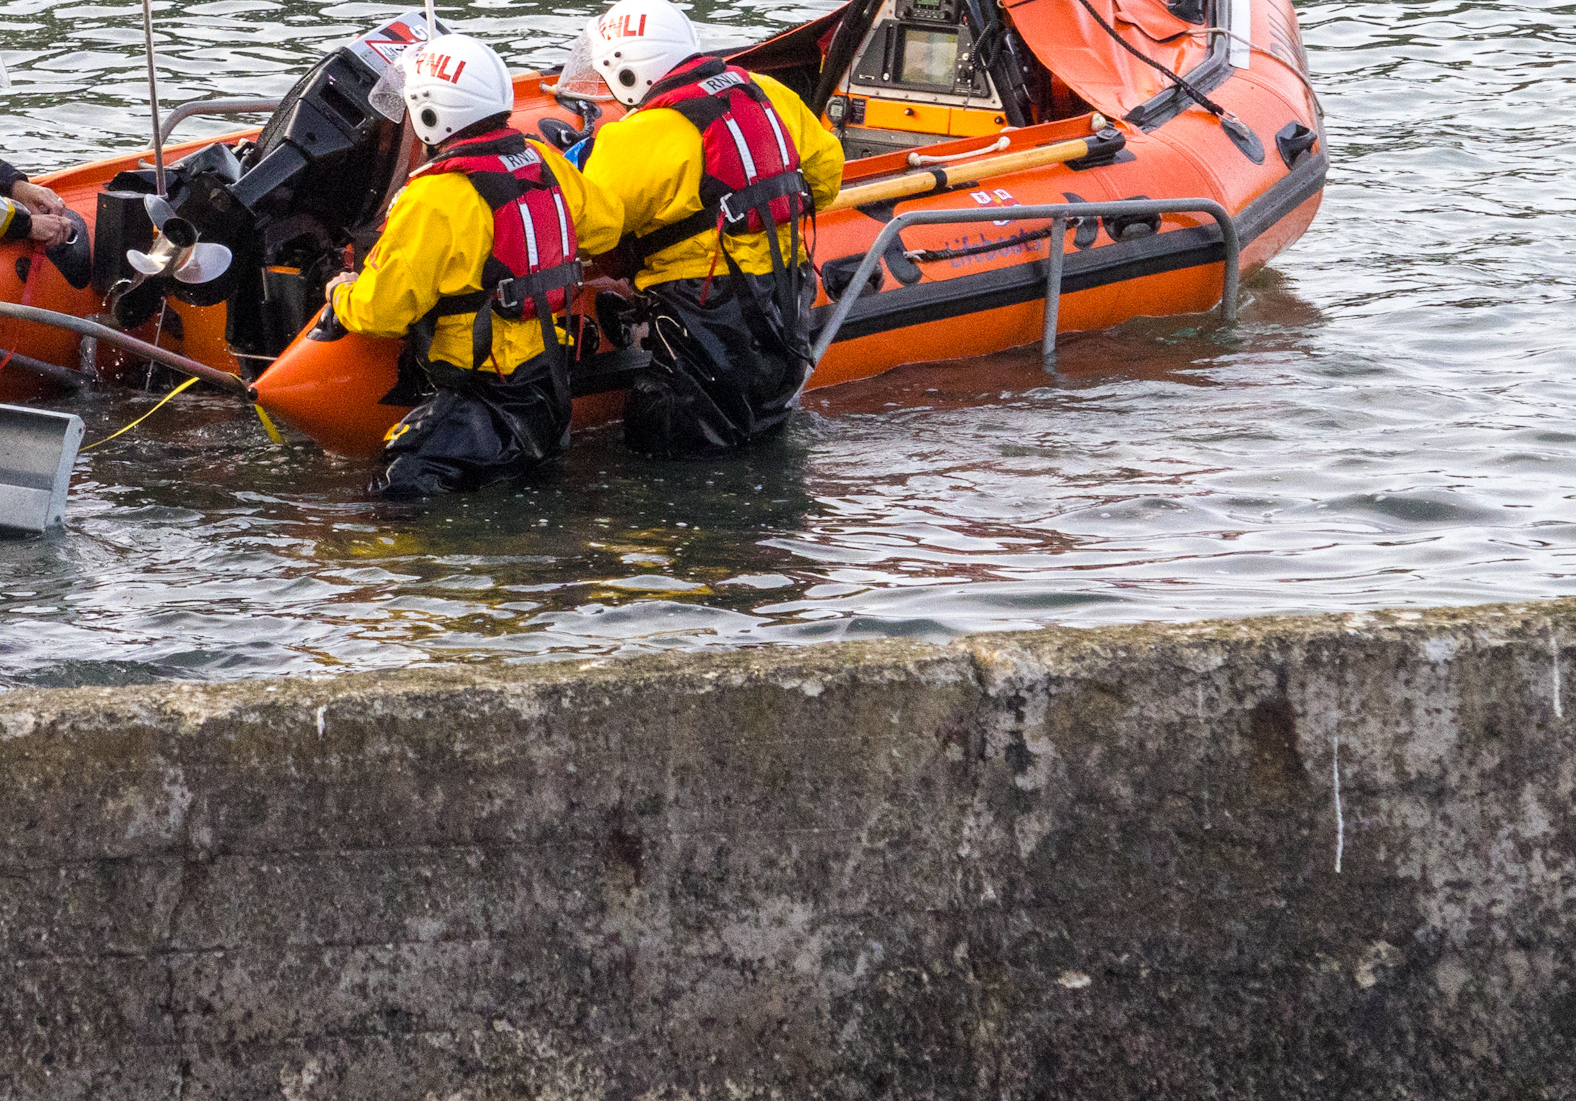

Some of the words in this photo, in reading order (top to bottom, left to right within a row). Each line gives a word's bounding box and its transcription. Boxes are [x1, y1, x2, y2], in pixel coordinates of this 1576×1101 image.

[706, 72, 740, 90] RNLI
[506, 149, 535, 168] RNLI
[944, 227, 1043, 268] Lifeboats
